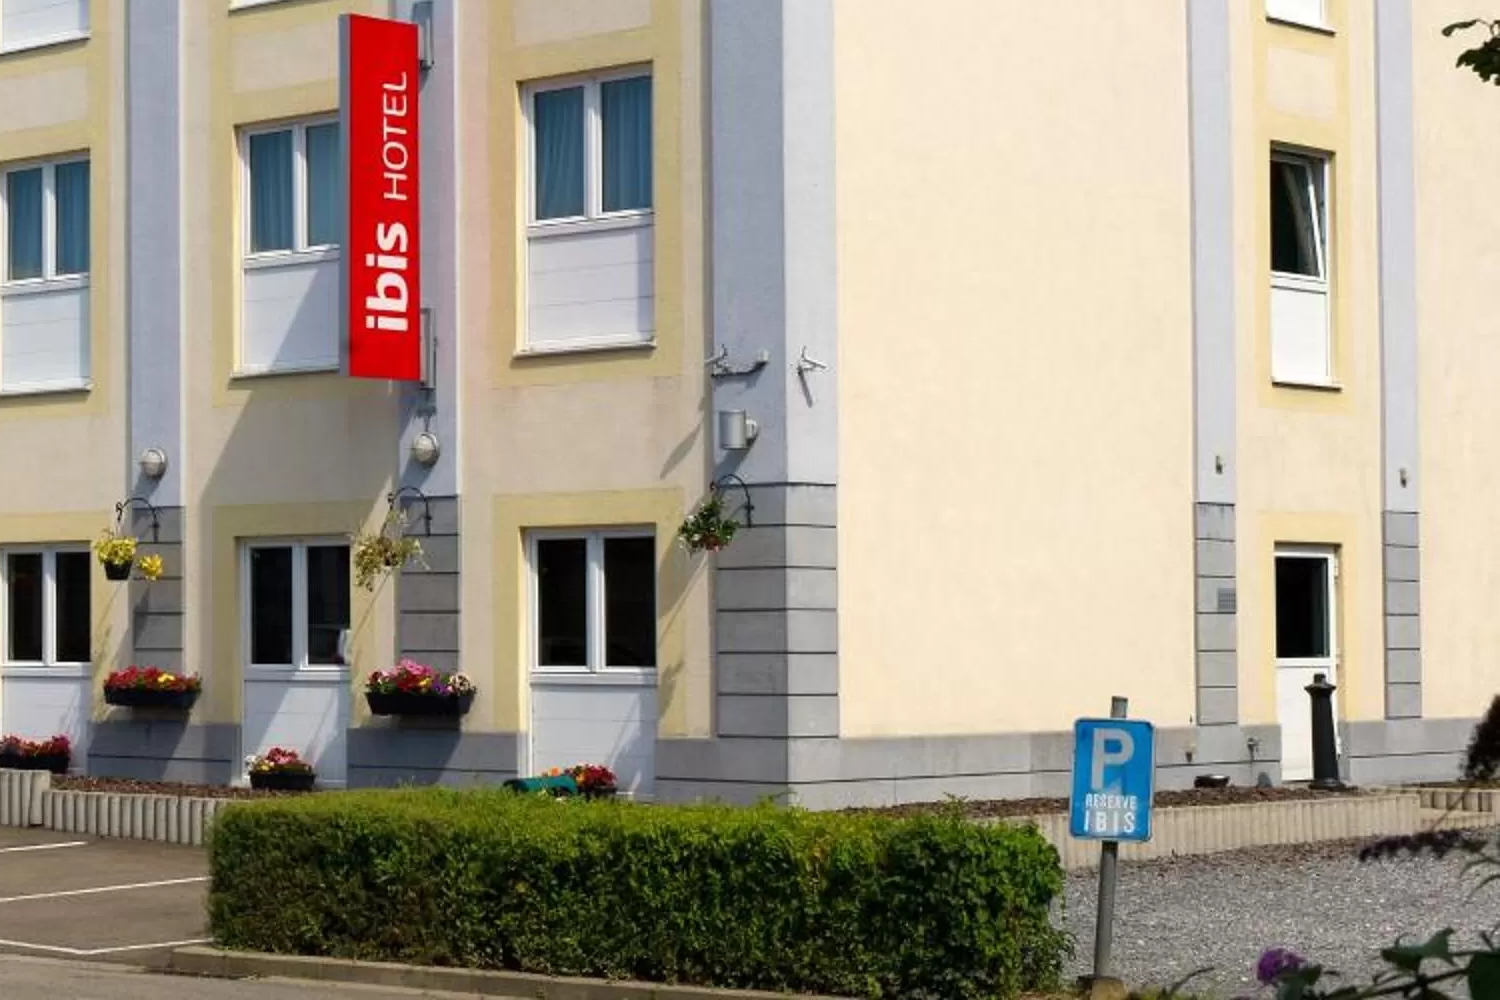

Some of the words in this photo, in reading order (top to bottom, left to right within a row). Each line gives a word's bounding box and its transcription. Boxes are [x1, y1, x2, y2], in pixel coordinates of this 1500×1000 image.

[383, 71, 408, 201] HOTEL
[365, 221, 409, 332] ibis
[1091, 727, 1135, 790] P
[1084, 809, 1136, 833] IBIS
